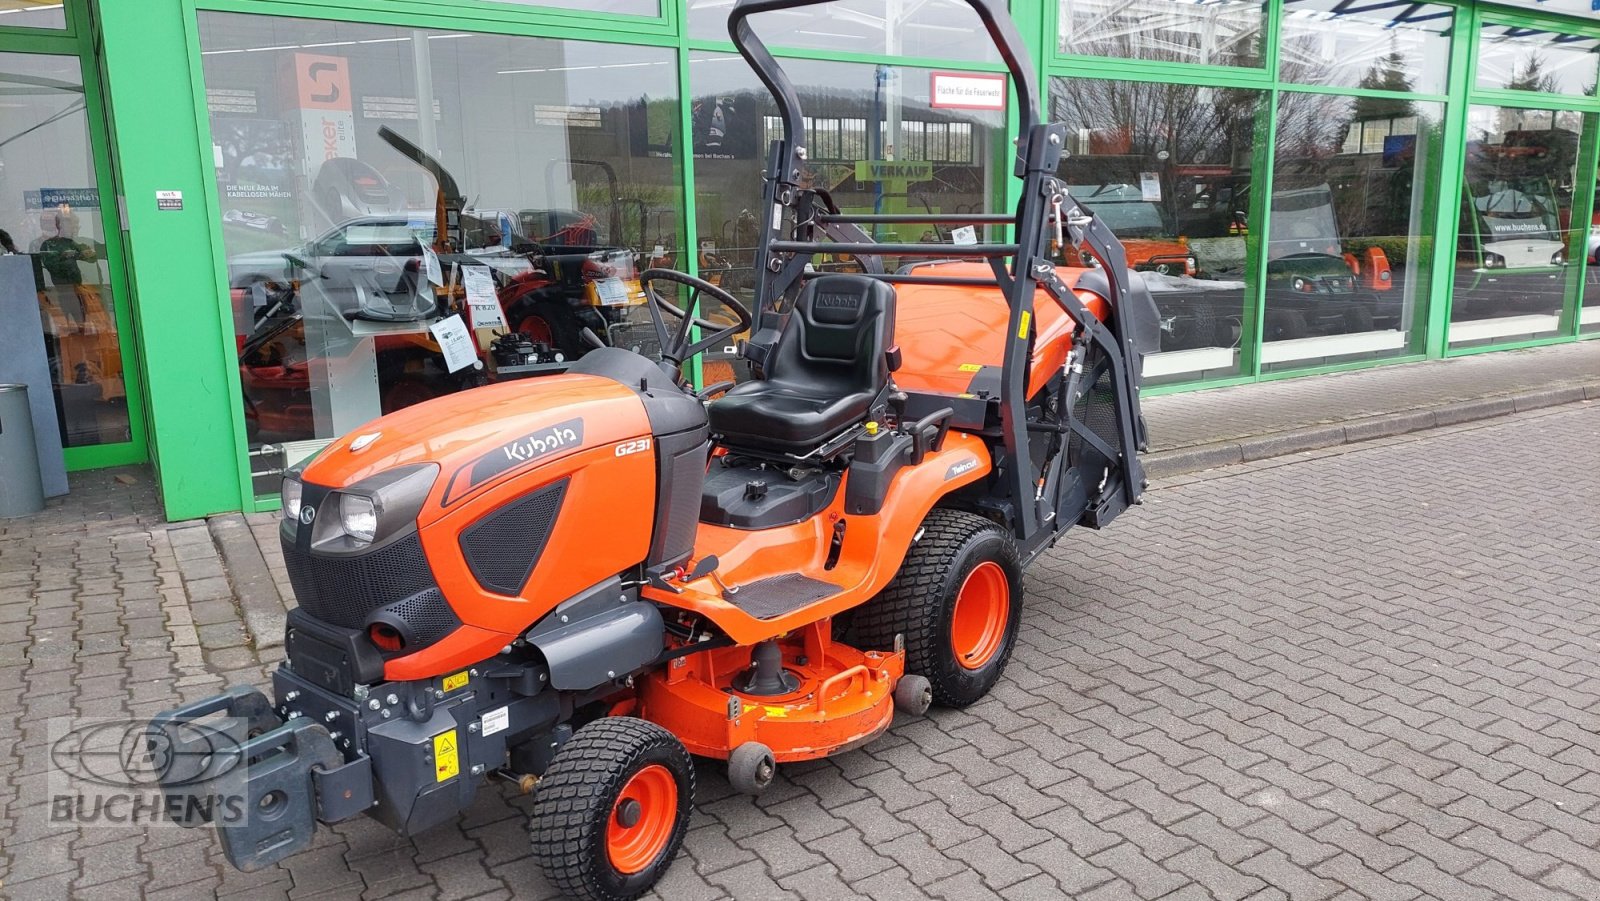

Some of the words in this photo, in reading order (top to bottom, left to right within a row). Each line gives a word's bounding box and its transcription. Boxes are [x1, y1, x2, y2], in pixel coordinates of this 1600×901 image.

[973, 87, 1000, 97] Feuerwehr
[870, 165, 929, 178] VERKAUF
[256, 183, 270, 191] ÄRA
[1494, 223, 1547, 232] www.buchens.de
[821, 293, 858, 307] Kubota
[503, 427, 577, 461] Kubota
[615, 438, 651, 457] G231
